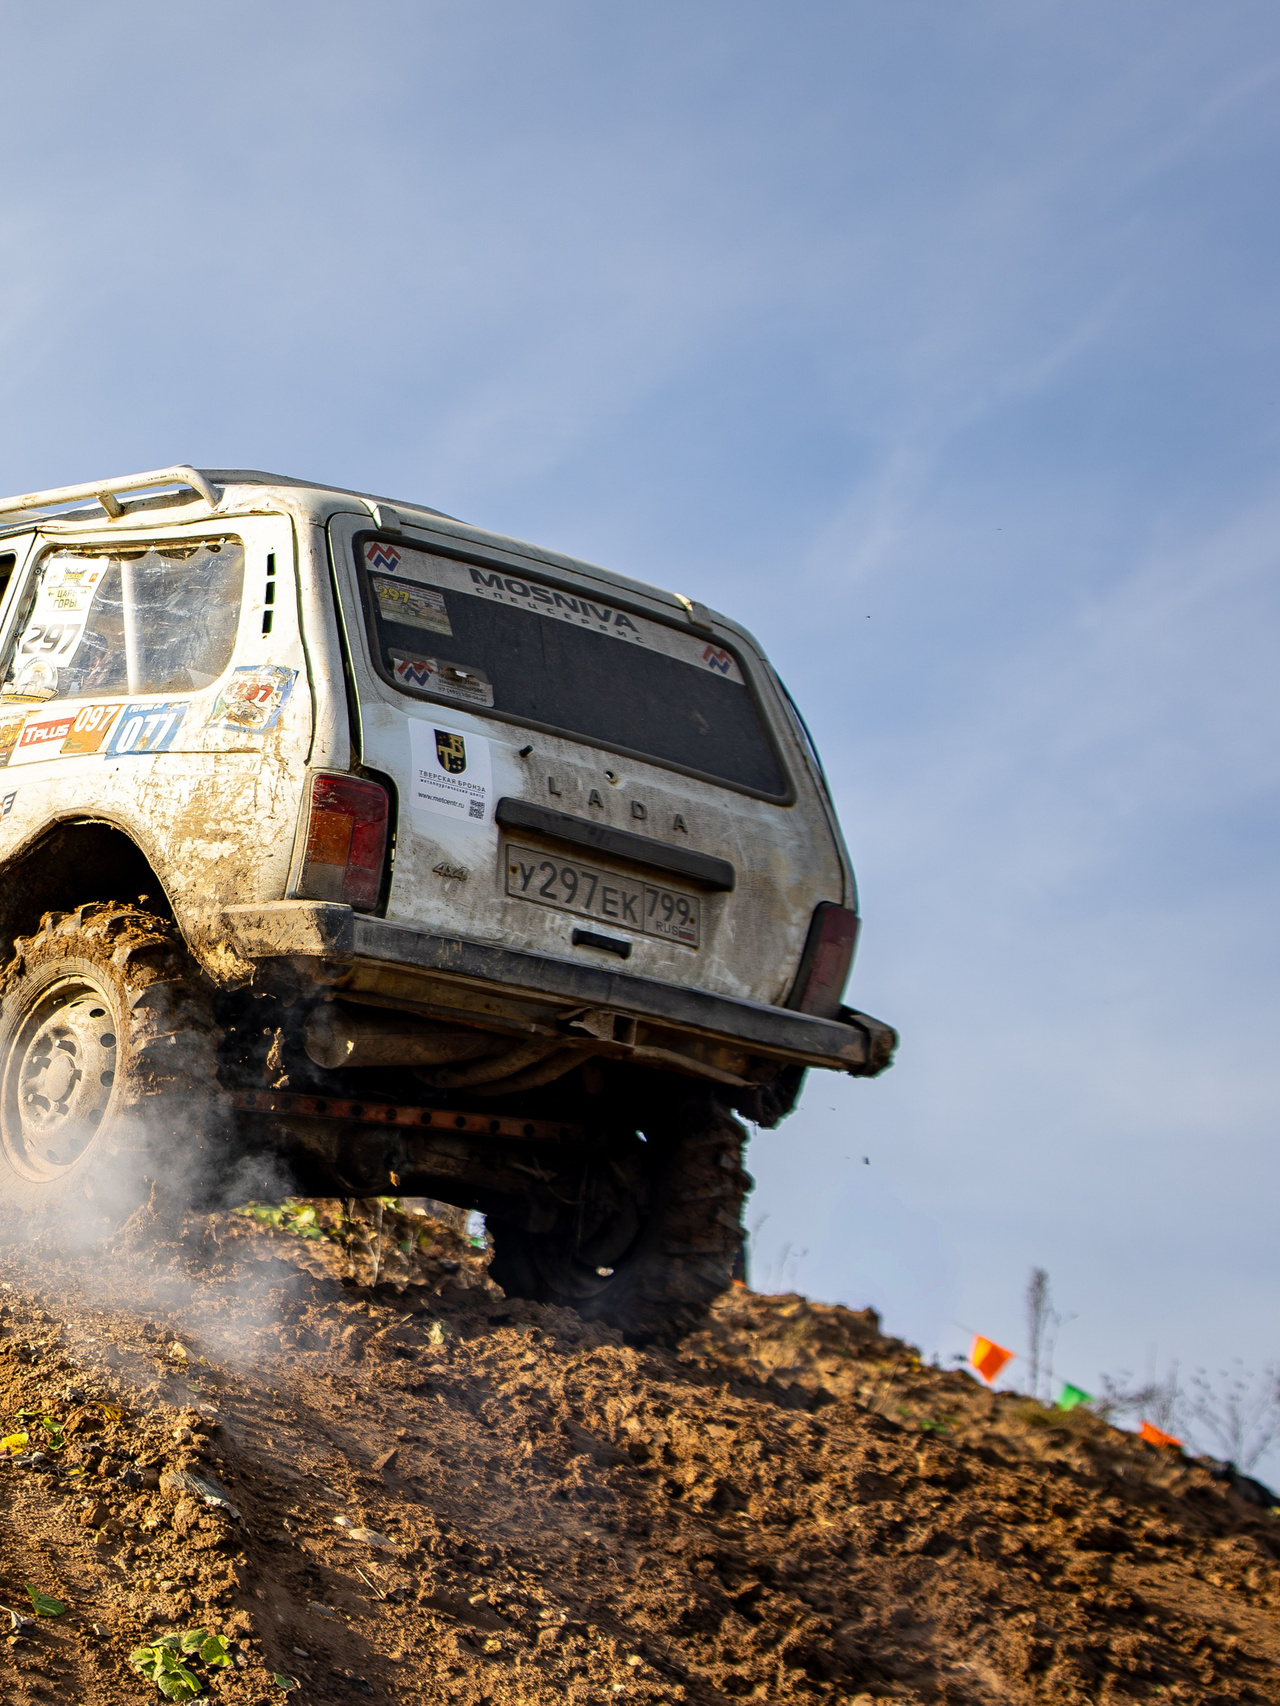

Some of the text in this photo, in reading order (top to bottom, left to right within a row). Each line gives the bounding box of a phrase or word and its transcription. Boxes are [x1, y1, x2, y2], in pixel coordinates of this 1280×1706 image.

[377, 585, 410, 604] 297
[469, 568, 640, 633] MOSNIVA
[21, 623, 82, 654] 297
[74, 706, 120, 732] 097
[116, 712, 177, 754] 077
[24, 724, 70, 743] TPLUS
[419, 770, 486, 793] ТВЕРСКАЯ БРОНЗА
[548, 776, 688, 834] LADA
[646, 888, 690, 926] 799
[655, 920, 679, 936] RUS
